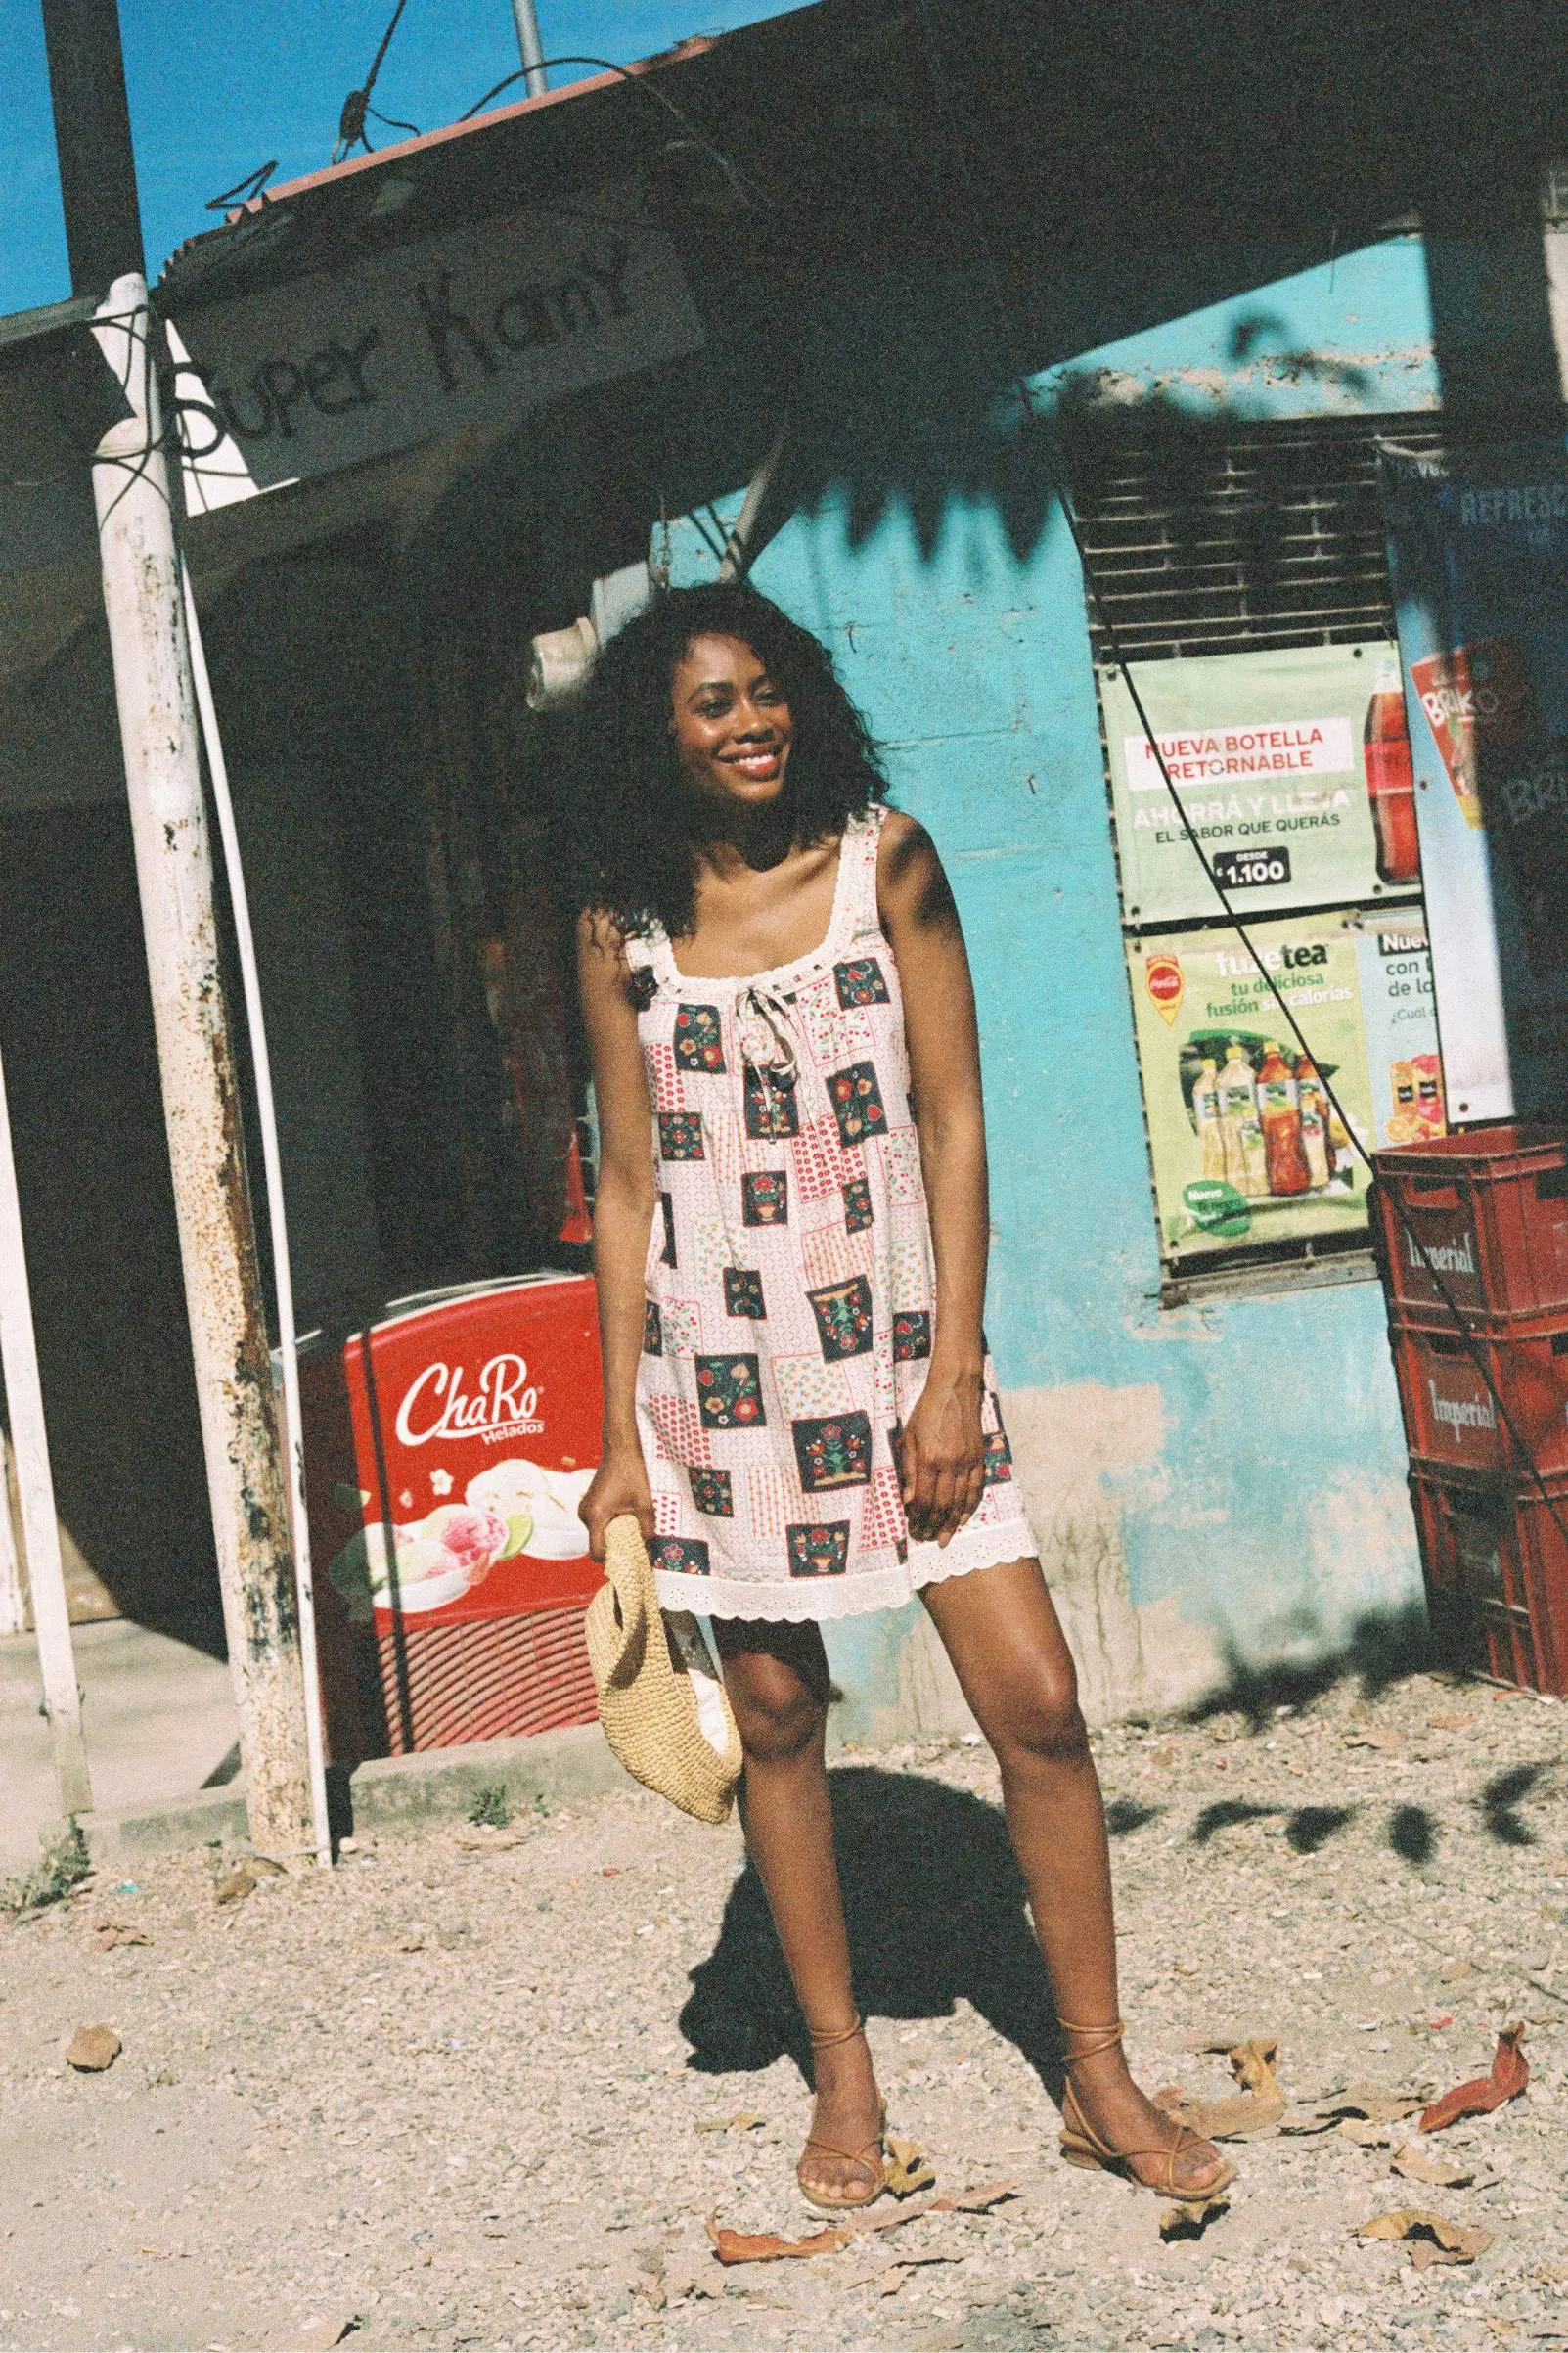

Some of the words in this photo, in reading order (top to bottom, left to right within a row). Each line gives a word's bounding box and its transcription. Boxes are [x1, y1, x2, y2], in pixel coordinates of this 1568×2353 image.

[1145, 737, 1219, 760] NUEVA
[1225, 727, 1323, 752] BOTELLA
[1166, 750, 1314, 779] RETORNABLE
[1247, 795, 1265, 817] Y
[1155, 831, 1176, 843] EL
[1180, 824, 1233, 841] SABOR
[1238, 820, 1272, 837] QUE
[1276, 811, 1341, 832] QUERÁS
[1386, 961, 1419, 975] con
[1231, 982, 1249, 996] tu
[1253, 973, 1324, 994] deliciosa
[1388, 980, 1411, 997] de
[1206, 996, 1259, 1018] fusión
[1291, 984, 1354, 1006] calorías
[395, 1353, 538, 1447] ChaRo
[1427, 1378, 1498, 1444] Imperial
[481, 1421, 545, 1445] Helados
